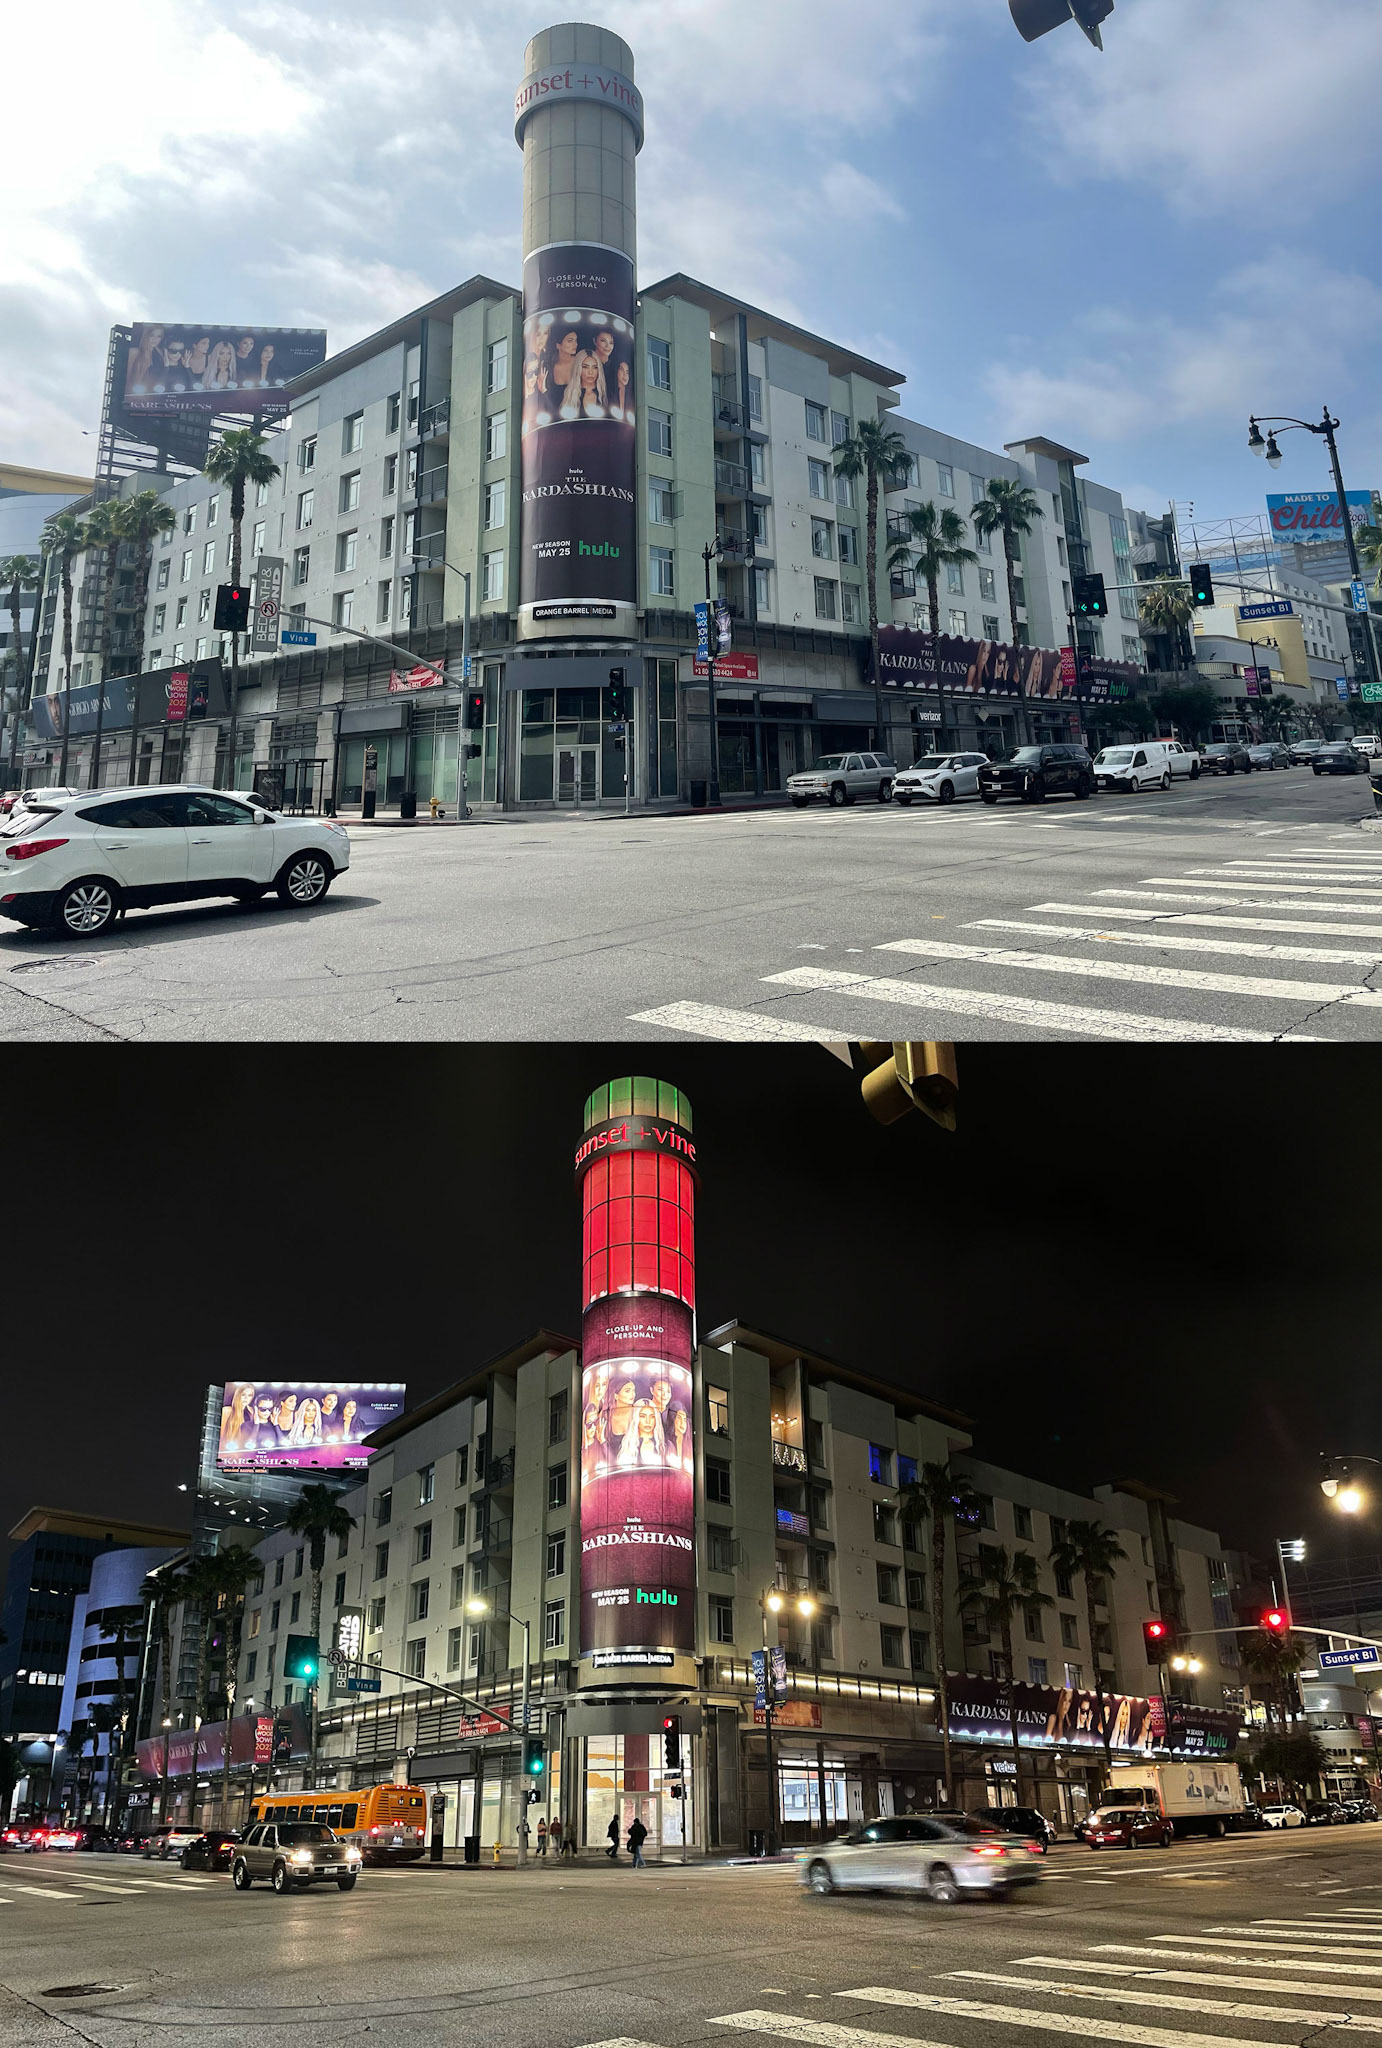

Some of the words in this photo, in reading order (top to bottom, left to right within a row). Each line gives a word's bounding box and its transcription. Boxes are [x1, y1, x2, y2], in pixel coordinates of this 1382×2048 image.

[515, 69, 574, 115] sunset
[597, 76, 640, 113] vine
[548, 274, 587, 284] CLOSE-UP
[590, 275, 607, 284] AND
[556, 281, 598, 289] PERSONAL
[522, 484, 634, 503] KARDASHIANS
[1285, 494, 1314, 503] MADE
[1270, 504, 1344, 530] Chill
[532, 542, 544, 550] NEW
[545, 540, 570, 548] SEASON
[578, 540, 620, 558] hulu
[538, 549, 558, 558] MAY
[559, 548, 570, 556] 25
[536, 608, 562, 616] ORANGE
[1244, 604, 1276, 616] Sunset
[290, 634, 309, 643] Vine
[1110, 681, 1129, 696] hulu
[652, 1126, 696, 1162] vine
[606, 1324, 644, 1335] CLOSE-UP
[646, 1326, 664, 1334] AND
[614, 1332, 656, 1340] PERSONAL
[582, 1532, 692, 1552] KARDASHIANS
[604, 1588, 630, 1596] SEASON
[636, 1588, 678, 1606] hulu
[598, 1596, 614, 1606] MAY
[617, 1595, 630, 1605] 25
[1325, 1653, 1360, 1664] Sunset
[356, 1682, 374, 1690] Vine
[1185, 1737, 1197, 1746] MAY
[1206, 1732, 1228, 1748] hulu
